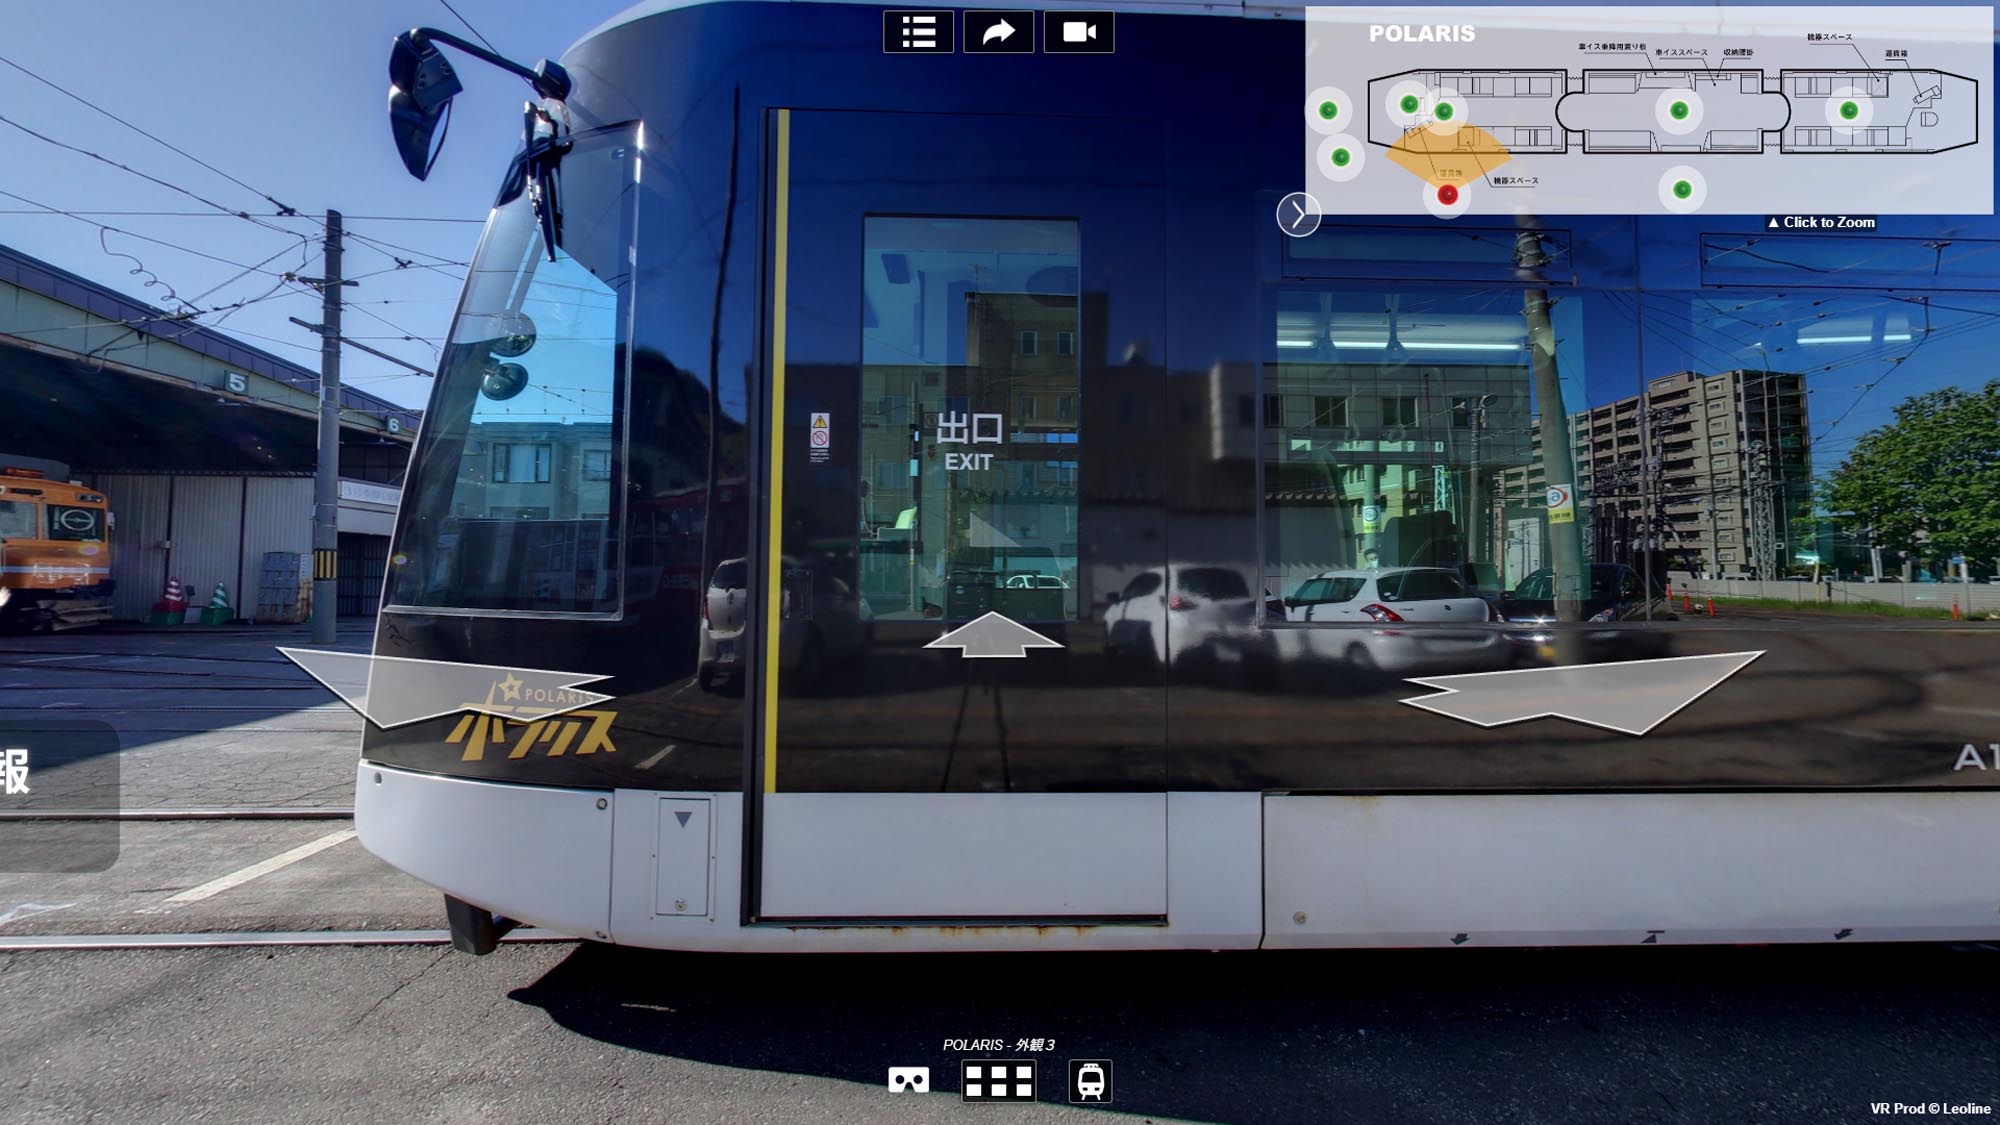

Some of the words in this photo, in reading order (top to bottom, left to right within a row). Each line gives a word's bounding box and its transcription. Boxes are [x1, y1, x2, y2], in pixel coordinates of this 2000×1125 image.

[229, 373, 246, 392] 5
[389, 418, 400, 432] 6
[937, 410, 1003, 444] 出口
[945, 453, 994, 471] EXIT
[524, 687, 595, 705] POLARIS
[1953, 743, 2000, 771] A1
